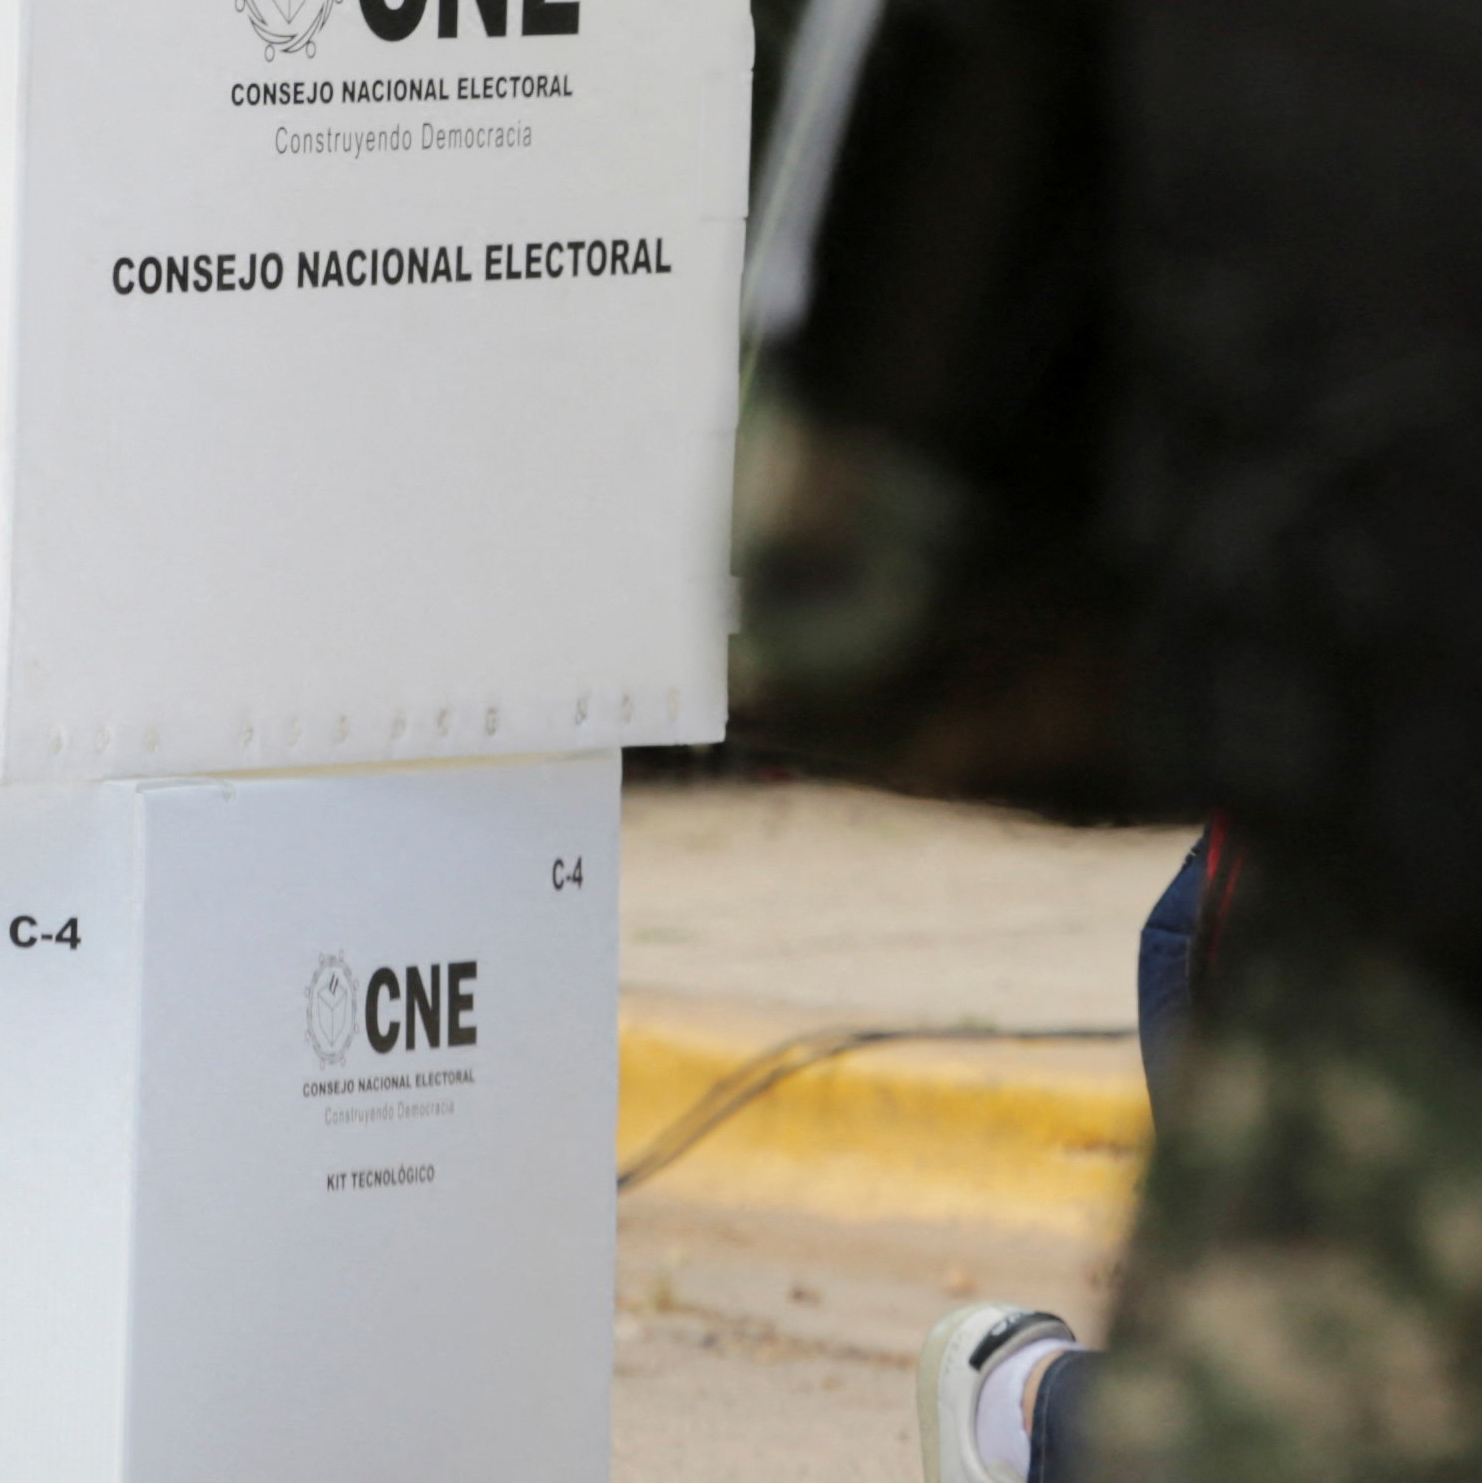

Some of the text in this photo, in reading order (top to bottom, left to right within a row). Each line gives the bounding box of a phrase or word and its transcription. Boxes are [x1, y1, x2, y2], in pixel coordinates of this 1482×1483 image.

[230, 74, 574, 107] CONSEJO NACIONAL ELECTORAL
[274, 121, 533, 160] Construyendo Democracia
[112, 237, 672, 296] CONSEJO NACIONAL ELECTORAL
[551, 856, 584, 892] C-4
[8, 914, 82, 951] C-4
[366, 961, 477, 1054] CNE
[302, 1068, 476, 1098] CONSEJO NACIONAL ELECTORAL
[326, 1164, 435, 1192] KIT TECNOLÓGICO
